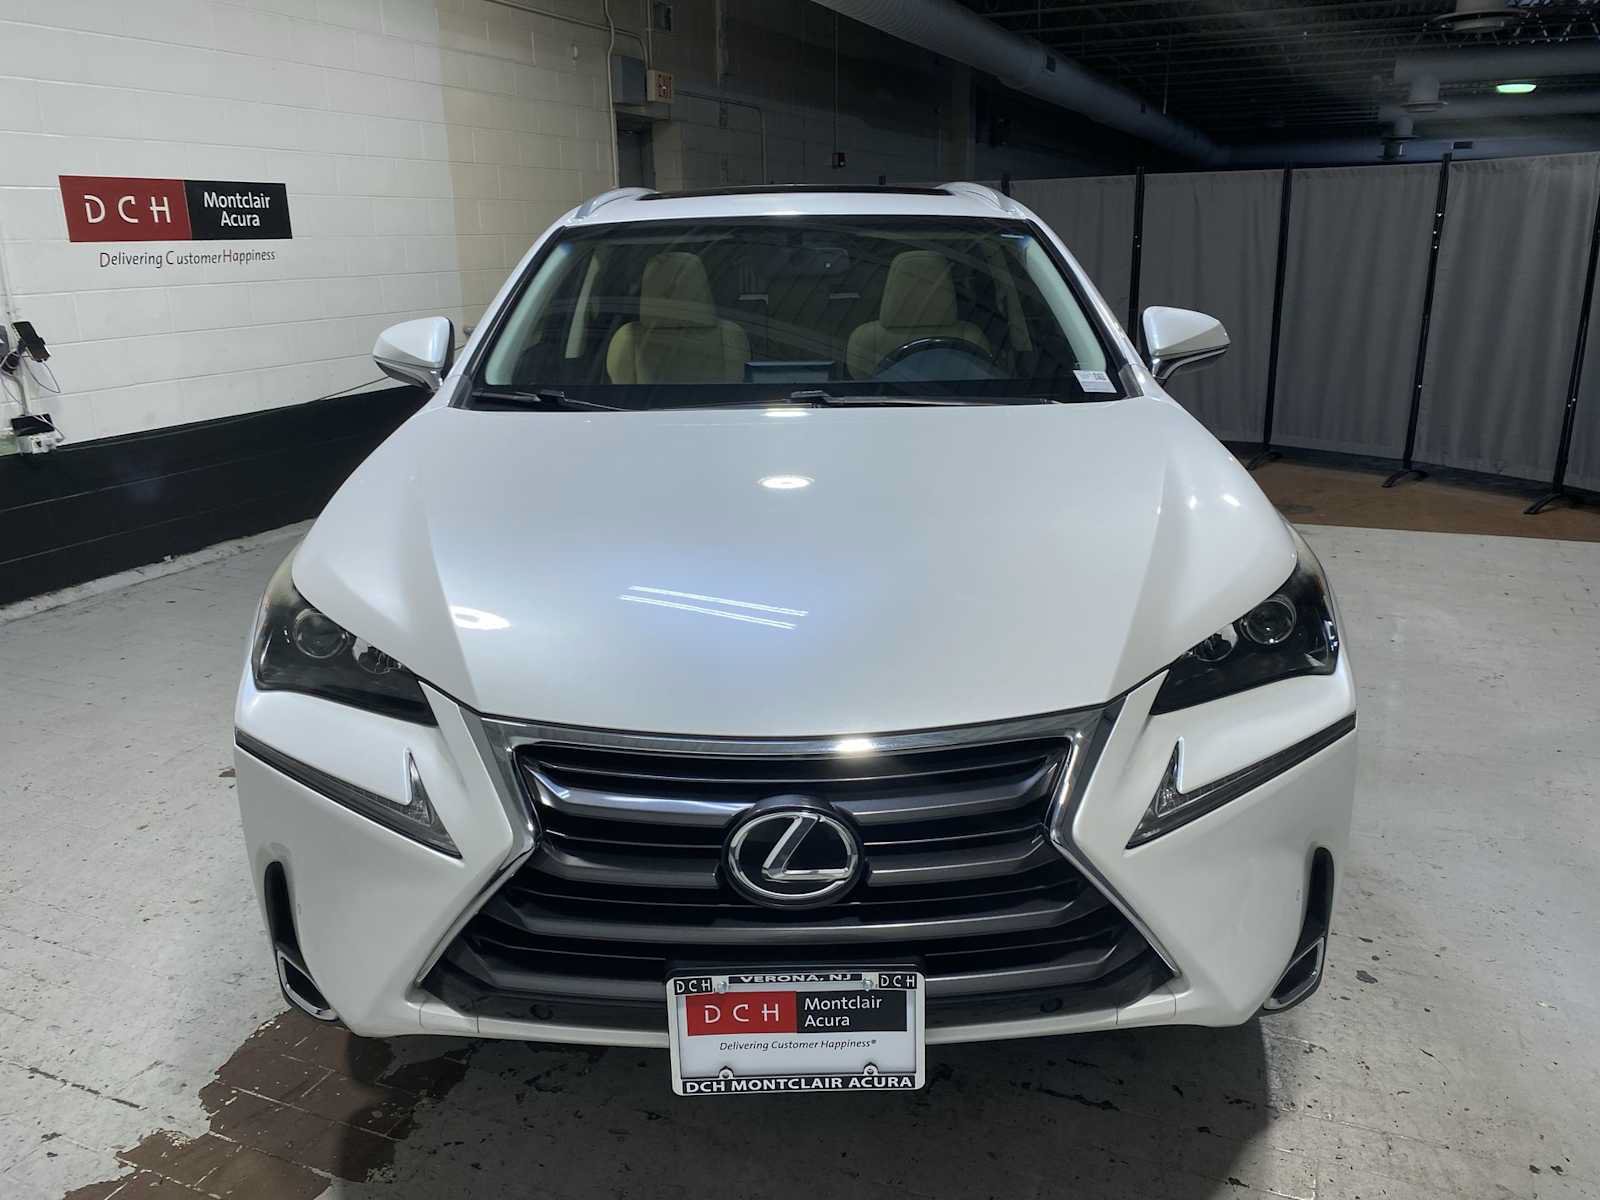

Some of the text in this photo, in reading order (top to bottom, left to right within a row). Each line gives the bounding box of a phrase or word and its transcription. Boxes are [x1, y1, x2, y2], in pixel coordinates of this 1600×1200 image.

[203, 191, 271, 209] Montclair
[220, 210, 261, 227] Acura
[99, 248, 276, 268] Delivering Customer Happiness
[829, 973, 851, 981] NJ
[881, 975, 915, 987] DCH
[676, 979, 711, 993] DCH
[804, 995, 882, 1011] Montclair
[804, 1014, 850, 1027] Acura
[719, 1040, 769, 1052] Delivering
[771, 1039, 818, 1050] Customer
[686, 1074, 912, 1094] DCH MONTCLAIR ACURA
